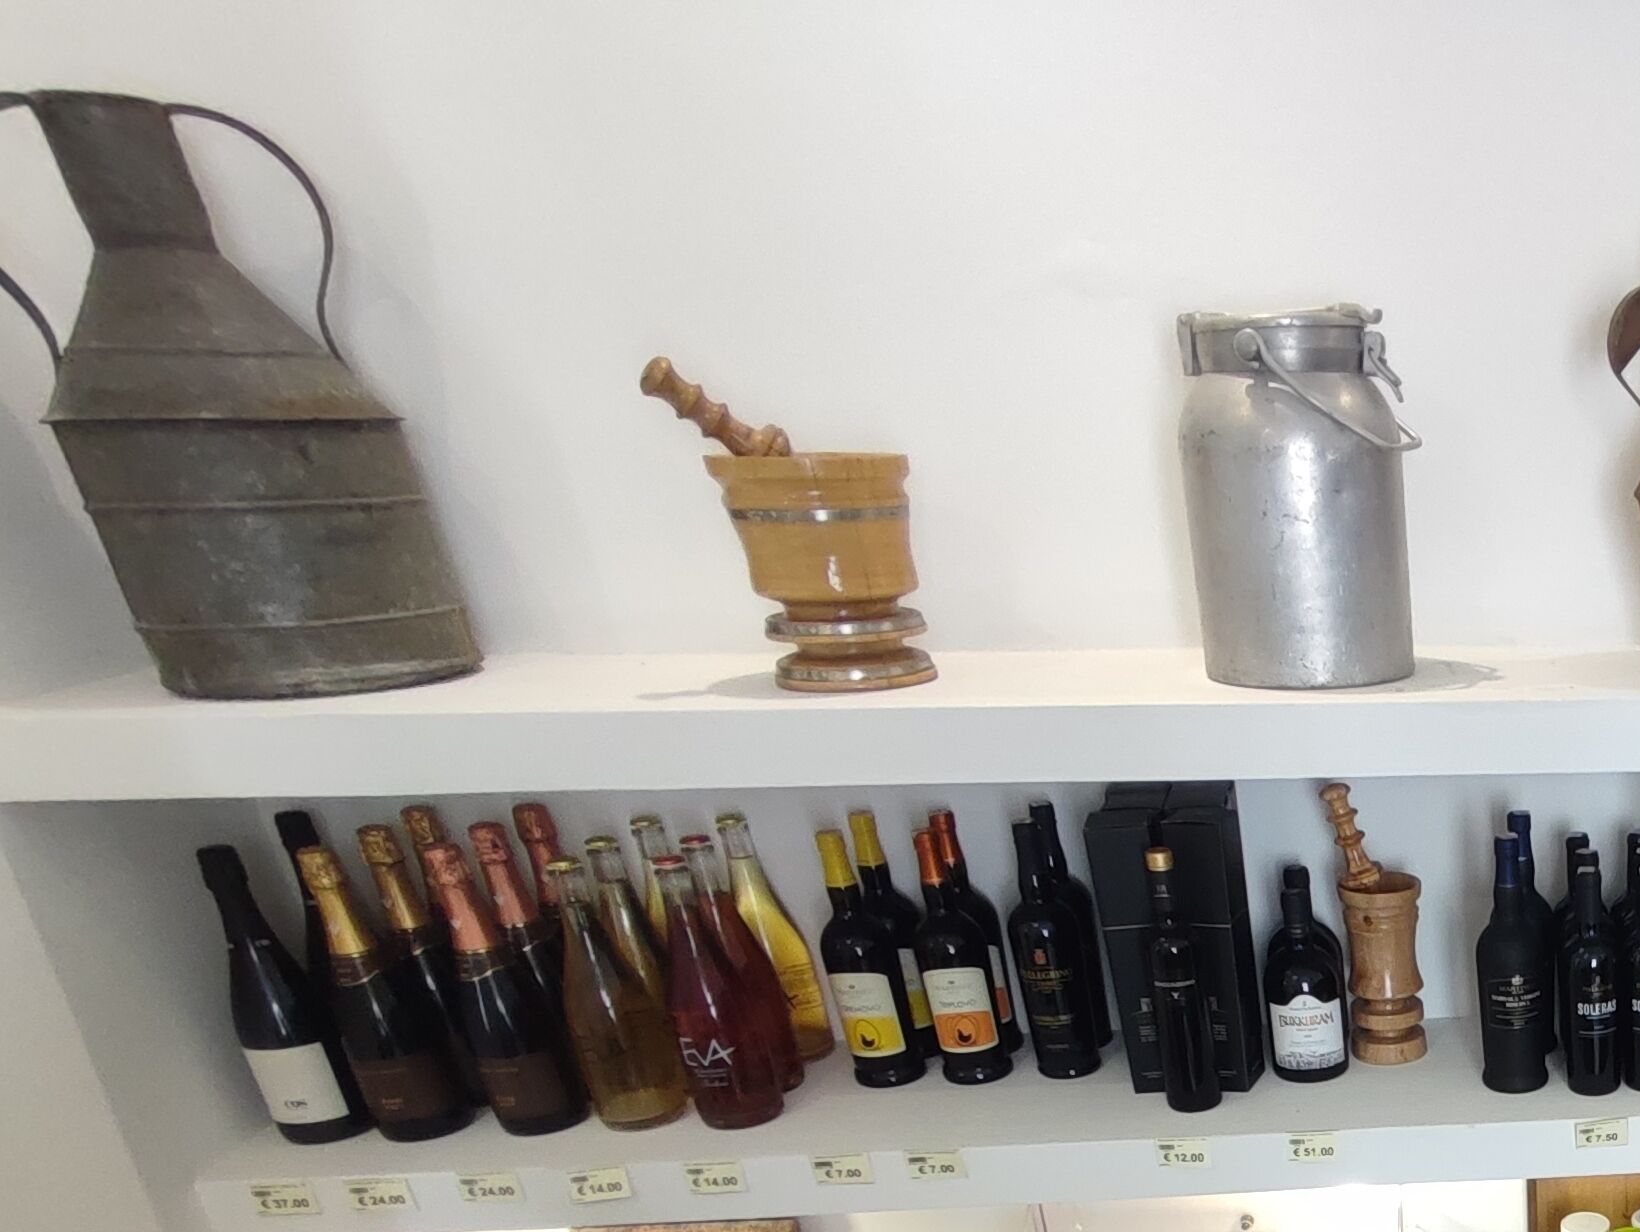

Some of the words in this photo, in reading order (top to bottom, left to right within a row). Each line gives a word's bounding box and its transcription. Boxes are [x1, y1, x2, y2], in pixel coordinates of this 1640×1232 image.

[1577, 999, 1617, 1015] SOLERAS
[1595, 1132, 1618, 1143] 7.50
[1163, 1153, 1172, 1162] €
[1174, 1153, 1205, 1162] 12.00
[1293, 1148, 1300, 1157] €
[1304, 1147, 1334, 1157] 51.00
[825, 1169, 834, 1178] €
[835, 1168, 862, 1178] 7.00
[918, 1165, 927, 1174] €
[928, 1164, 955, 1174] 7.00
[692, 1178, 701, 1187] €
[704, 1176, 738, 1187] 14.00
[468, 1187, 477, 1197] €
[478, 1186, 515, 1197] 24.00
[577, 1185, 587, 1195] €
[261, 1199, 271, 1209] €
[272, 1198, 310, 1209] 37.00
[358, 1196, 368, 1206] €
[369, 1195, 406, 1206] 24.00
